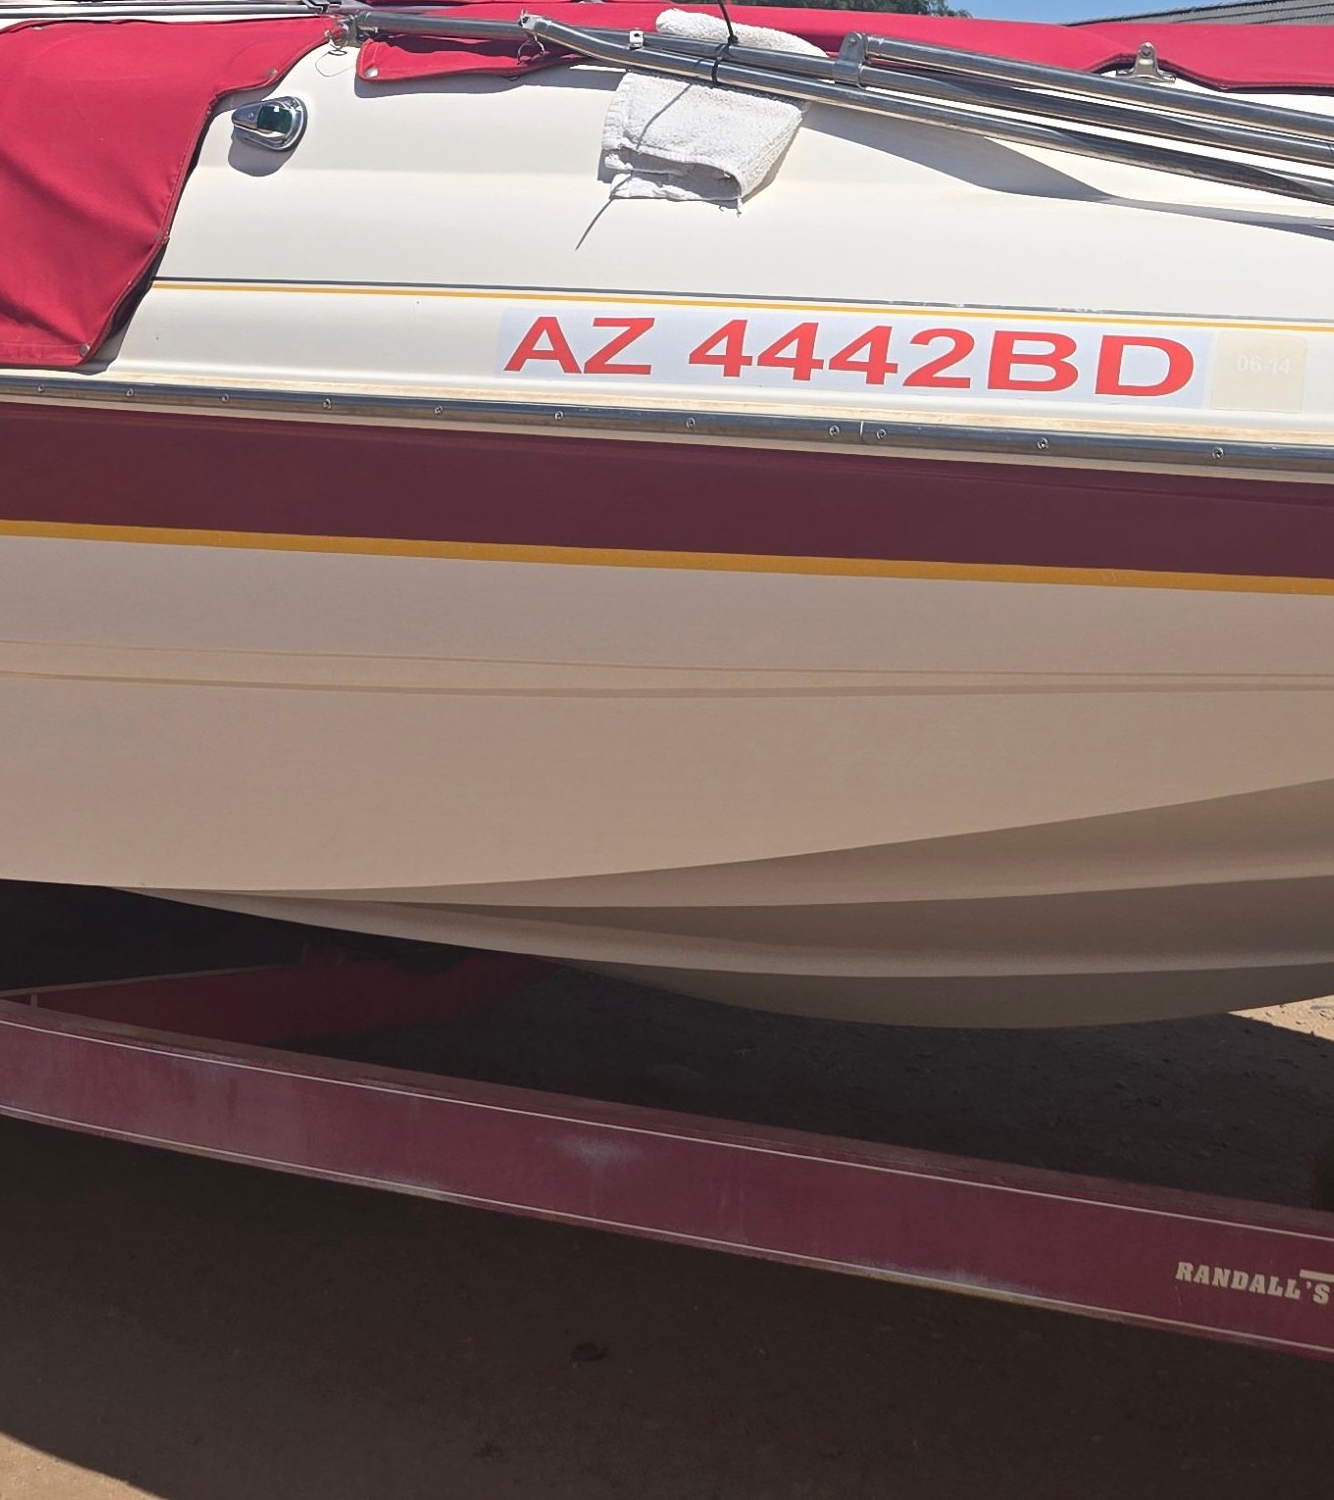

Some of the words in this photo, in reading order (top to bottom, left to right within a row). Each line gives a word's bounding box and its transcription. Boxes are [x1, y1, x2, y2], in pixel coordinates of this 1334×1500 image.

[505, 316, 655, 375] AZ
[689, 319, 1194, 397] 4442BD
[1175, 1261, 1330, 1304] RANDALL'S
